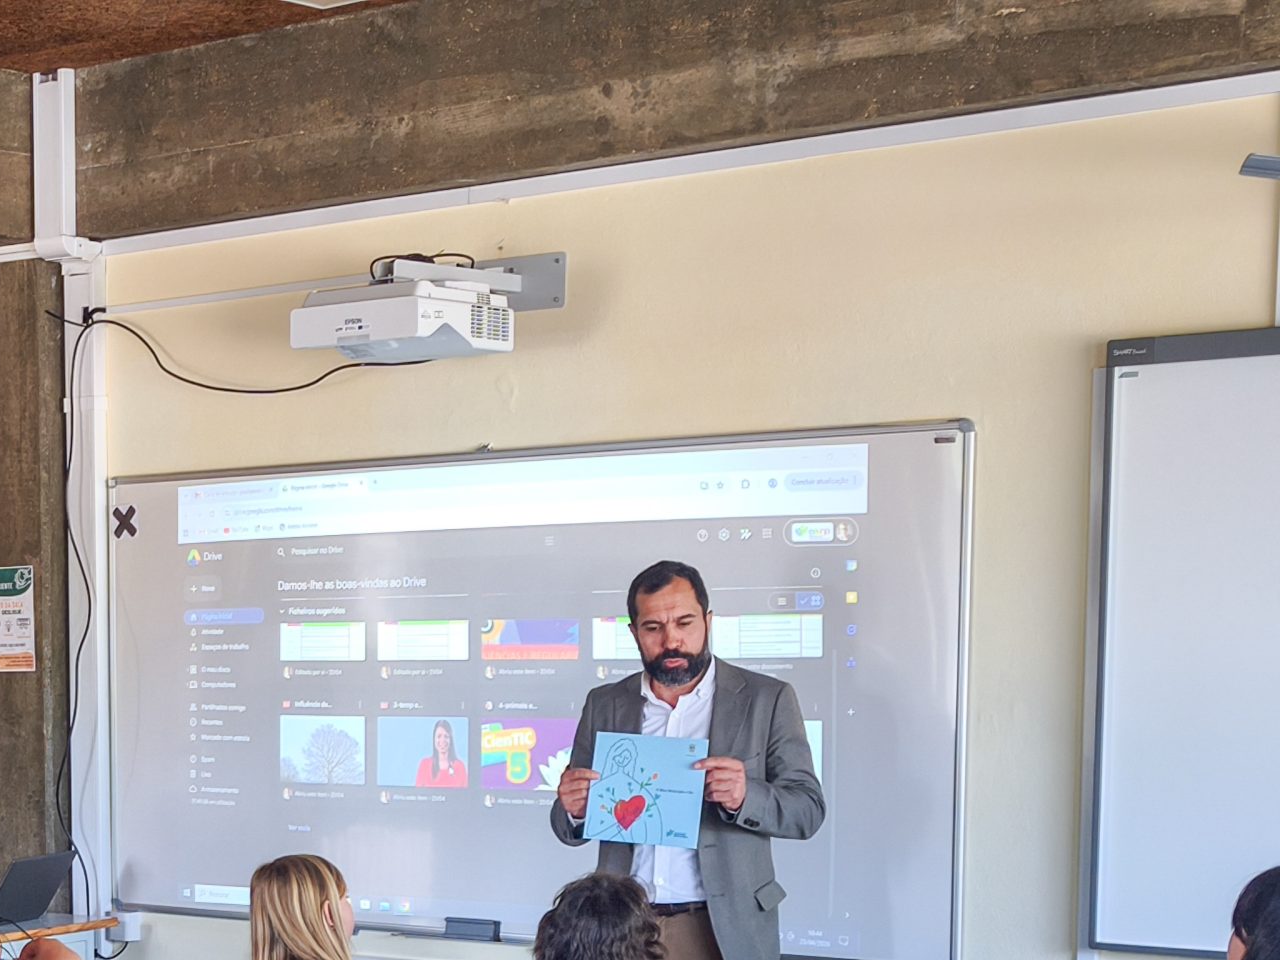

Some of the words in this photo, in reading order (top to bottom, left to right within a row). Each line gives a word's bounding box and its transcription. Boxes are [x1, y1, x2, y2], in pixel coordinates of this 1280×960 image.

[328, 546, 344, 554] Drive
[203, 552, 222, 561] Drive
[278, 579, 323, 591] Damos-lhe
[324, 581, 334, 590] as
[336, 578, 388, 590] boas-vindas
[390, 578, 401, 588] ao
[403, 576, 426, 587] Drive
[484, 732, 533, 749] CienTIC
